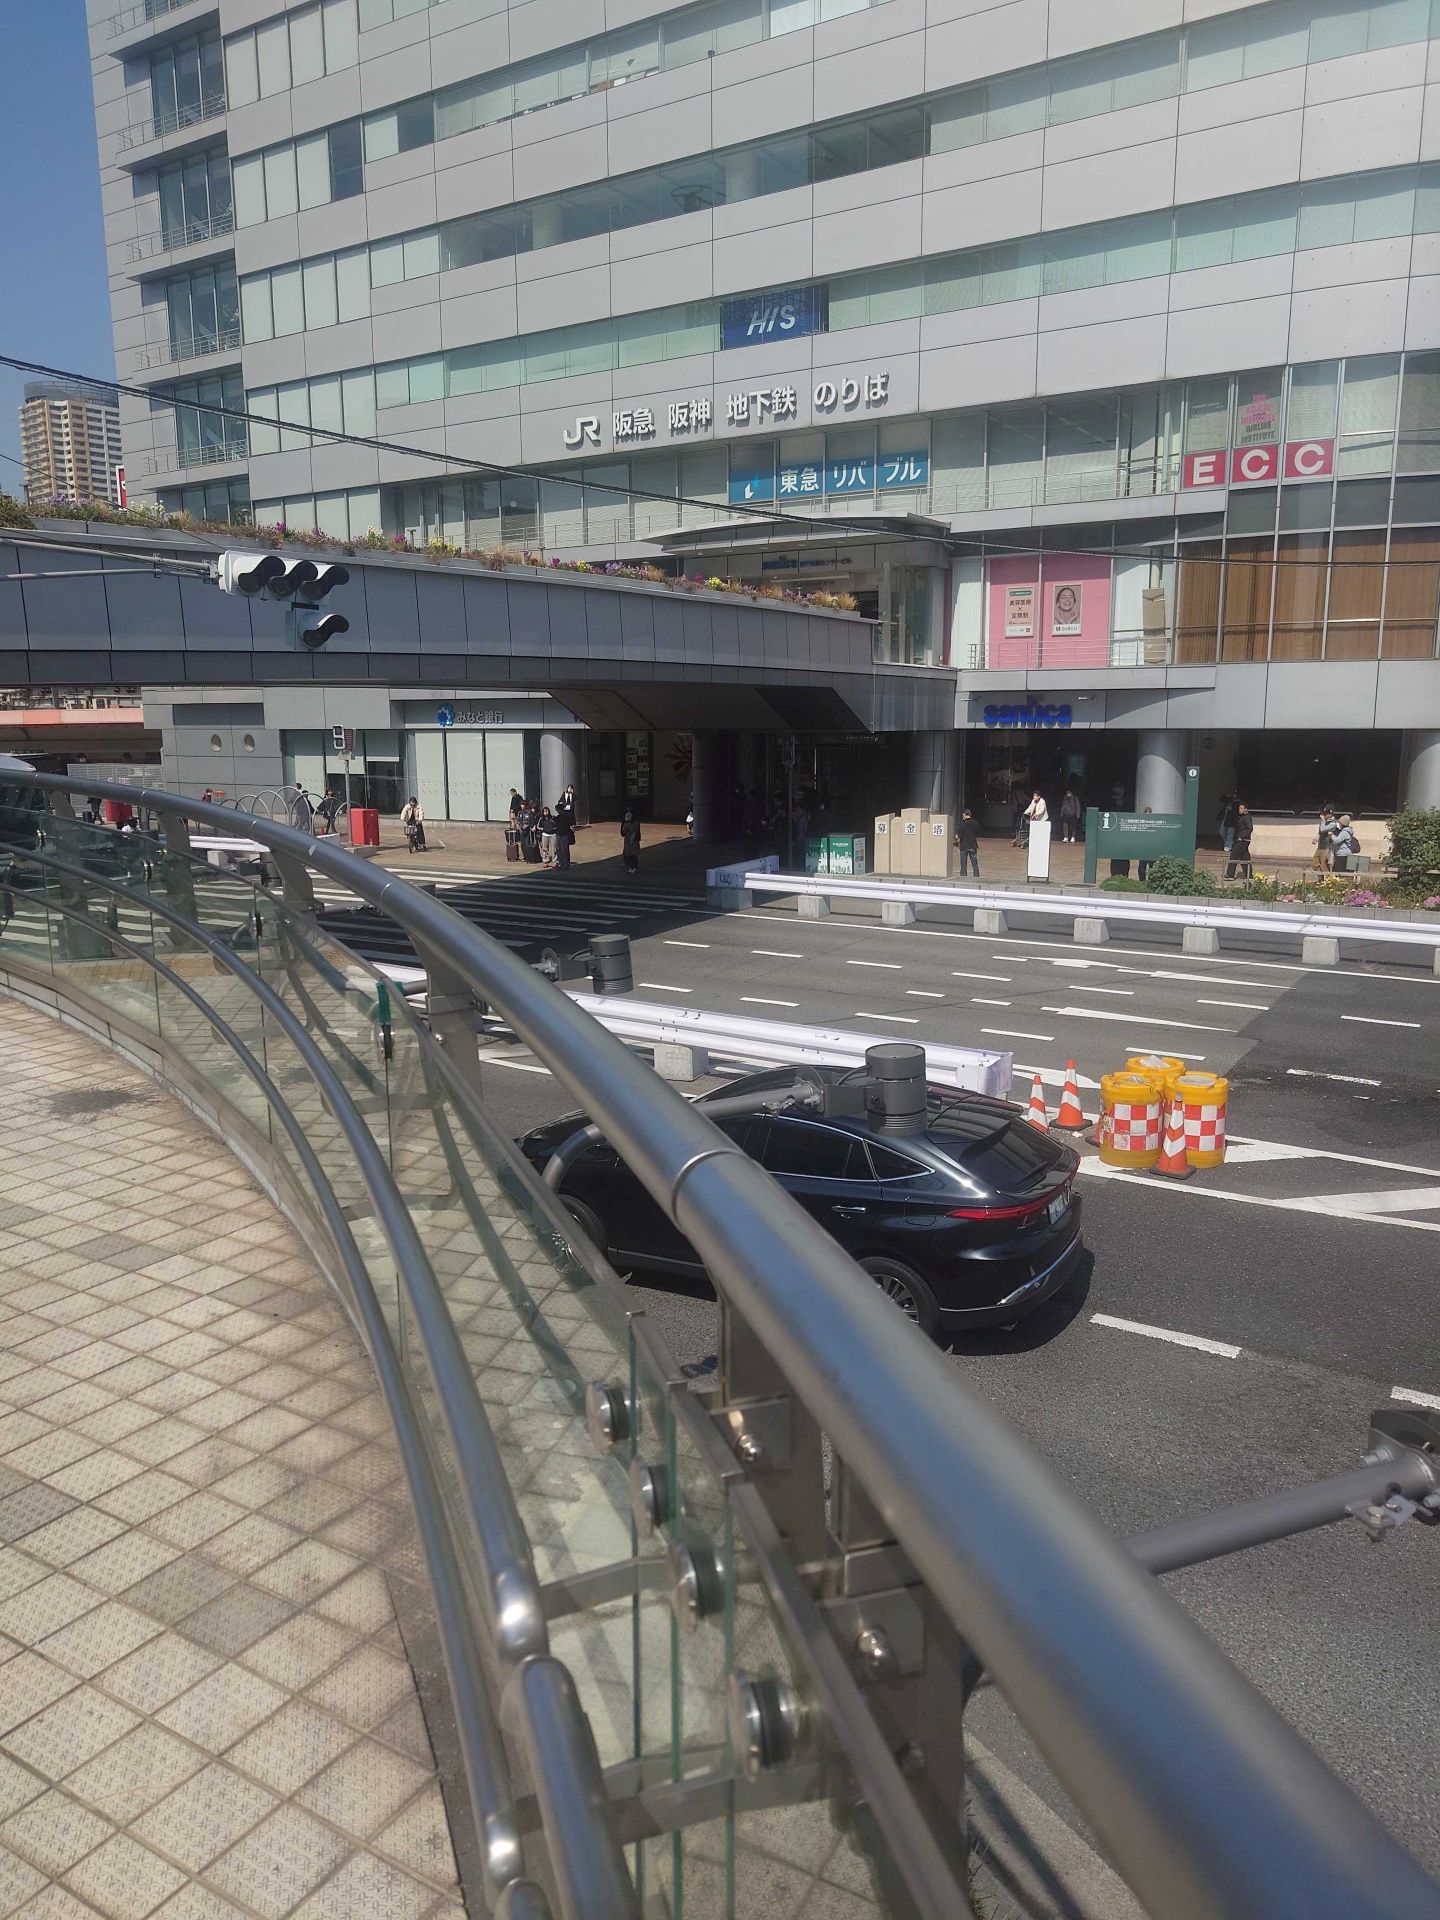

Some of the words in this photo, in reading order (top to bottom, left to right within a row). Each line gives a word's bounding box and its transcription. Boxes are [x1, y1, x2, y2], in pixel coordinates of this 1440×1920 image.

[563, 415, 602, 445] JR
[613, 407, 656, 438] 阪急
[668, 397, 711, 430] 阪神
[726, 385, 797, 421] 地下鉄
[813, 371, 889, 408] のりば
[1192, 443, 1326, 485] ECC
[456, 711, 504, 724] みなと銀行
